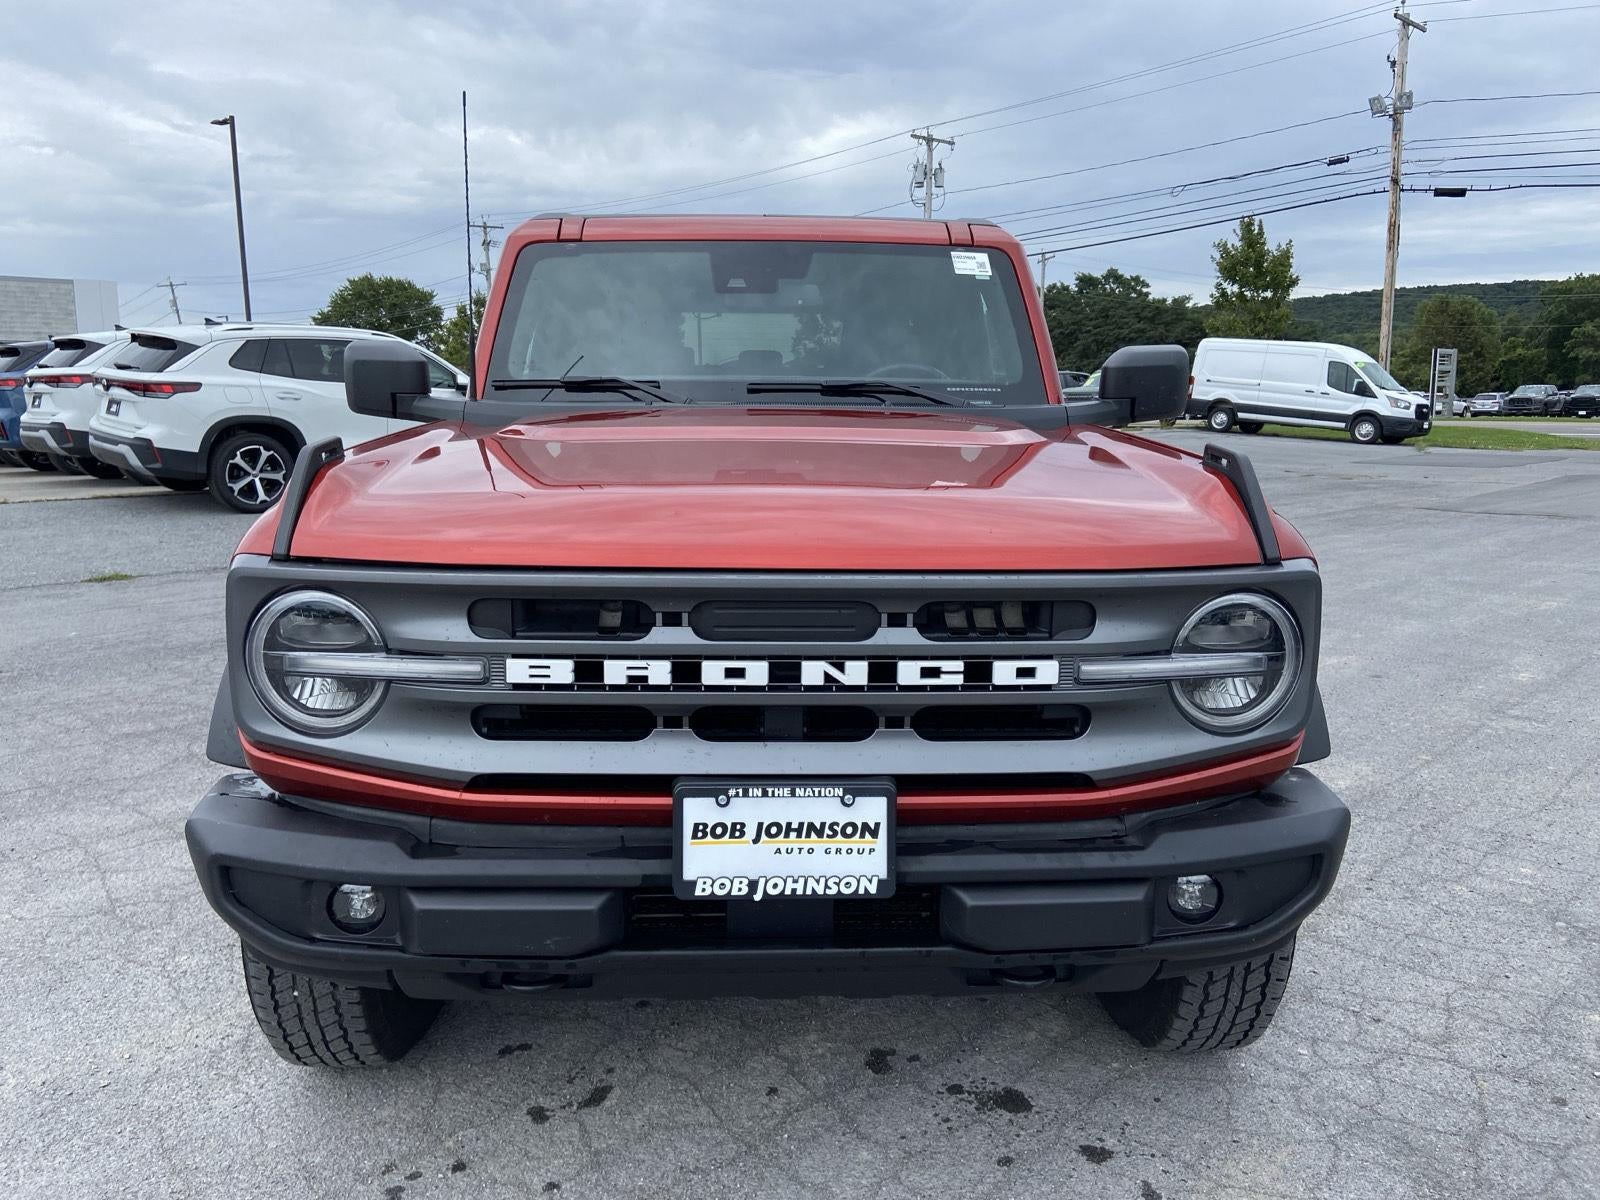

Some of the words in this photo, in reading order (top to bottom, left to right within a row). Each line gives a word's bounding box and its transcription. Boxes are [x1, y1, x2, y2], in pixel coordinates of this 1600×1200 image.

[506, 658, 1059, 685] BRONCO
[728, 788, 743, 797] #1
[749, 788, 762, 797] IN
[766, 788, 791, 797] THE
[796, 787, 843, 797] NATION
[691, 822, 746, 840] BOB
[752, 821, 881, 845] JOHNSON
[774, 847, 815, 855] AUTO
[824, 847, 876, 855] GROUP
[694, 876, 749, 896] BOB
[753, 875, 879, 901] JOHNSON
